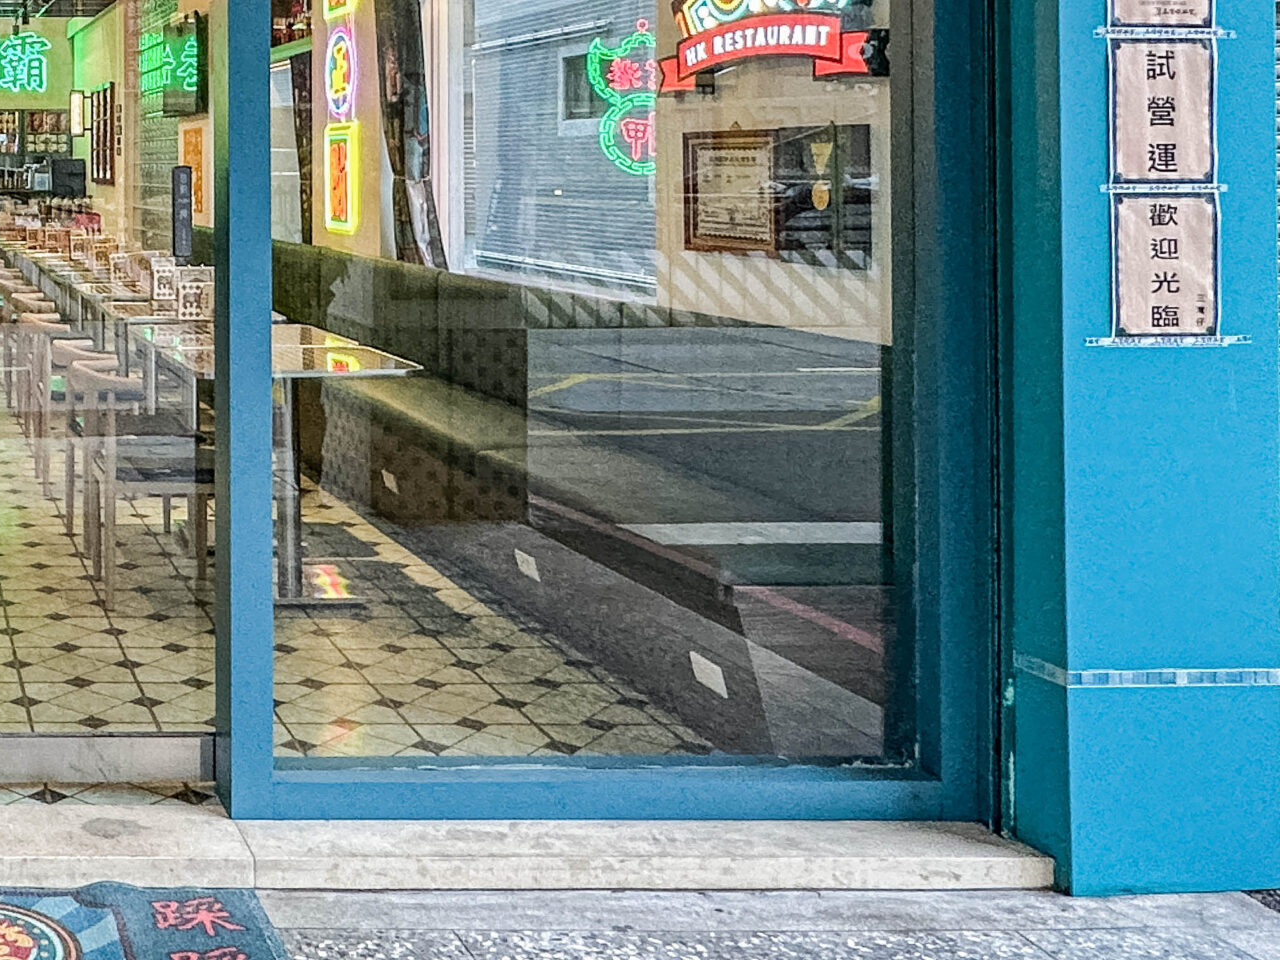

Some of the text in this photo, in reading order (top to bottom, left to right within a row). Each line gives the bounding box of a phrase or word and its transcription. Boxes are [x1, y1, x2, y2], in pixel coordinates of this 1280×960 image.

[685, 24, 830, 66] HK RESTAURANT
[1146, 49, 1178, 173] 試營運
[1149, 203, 1181, 328] 歡迎光臨
